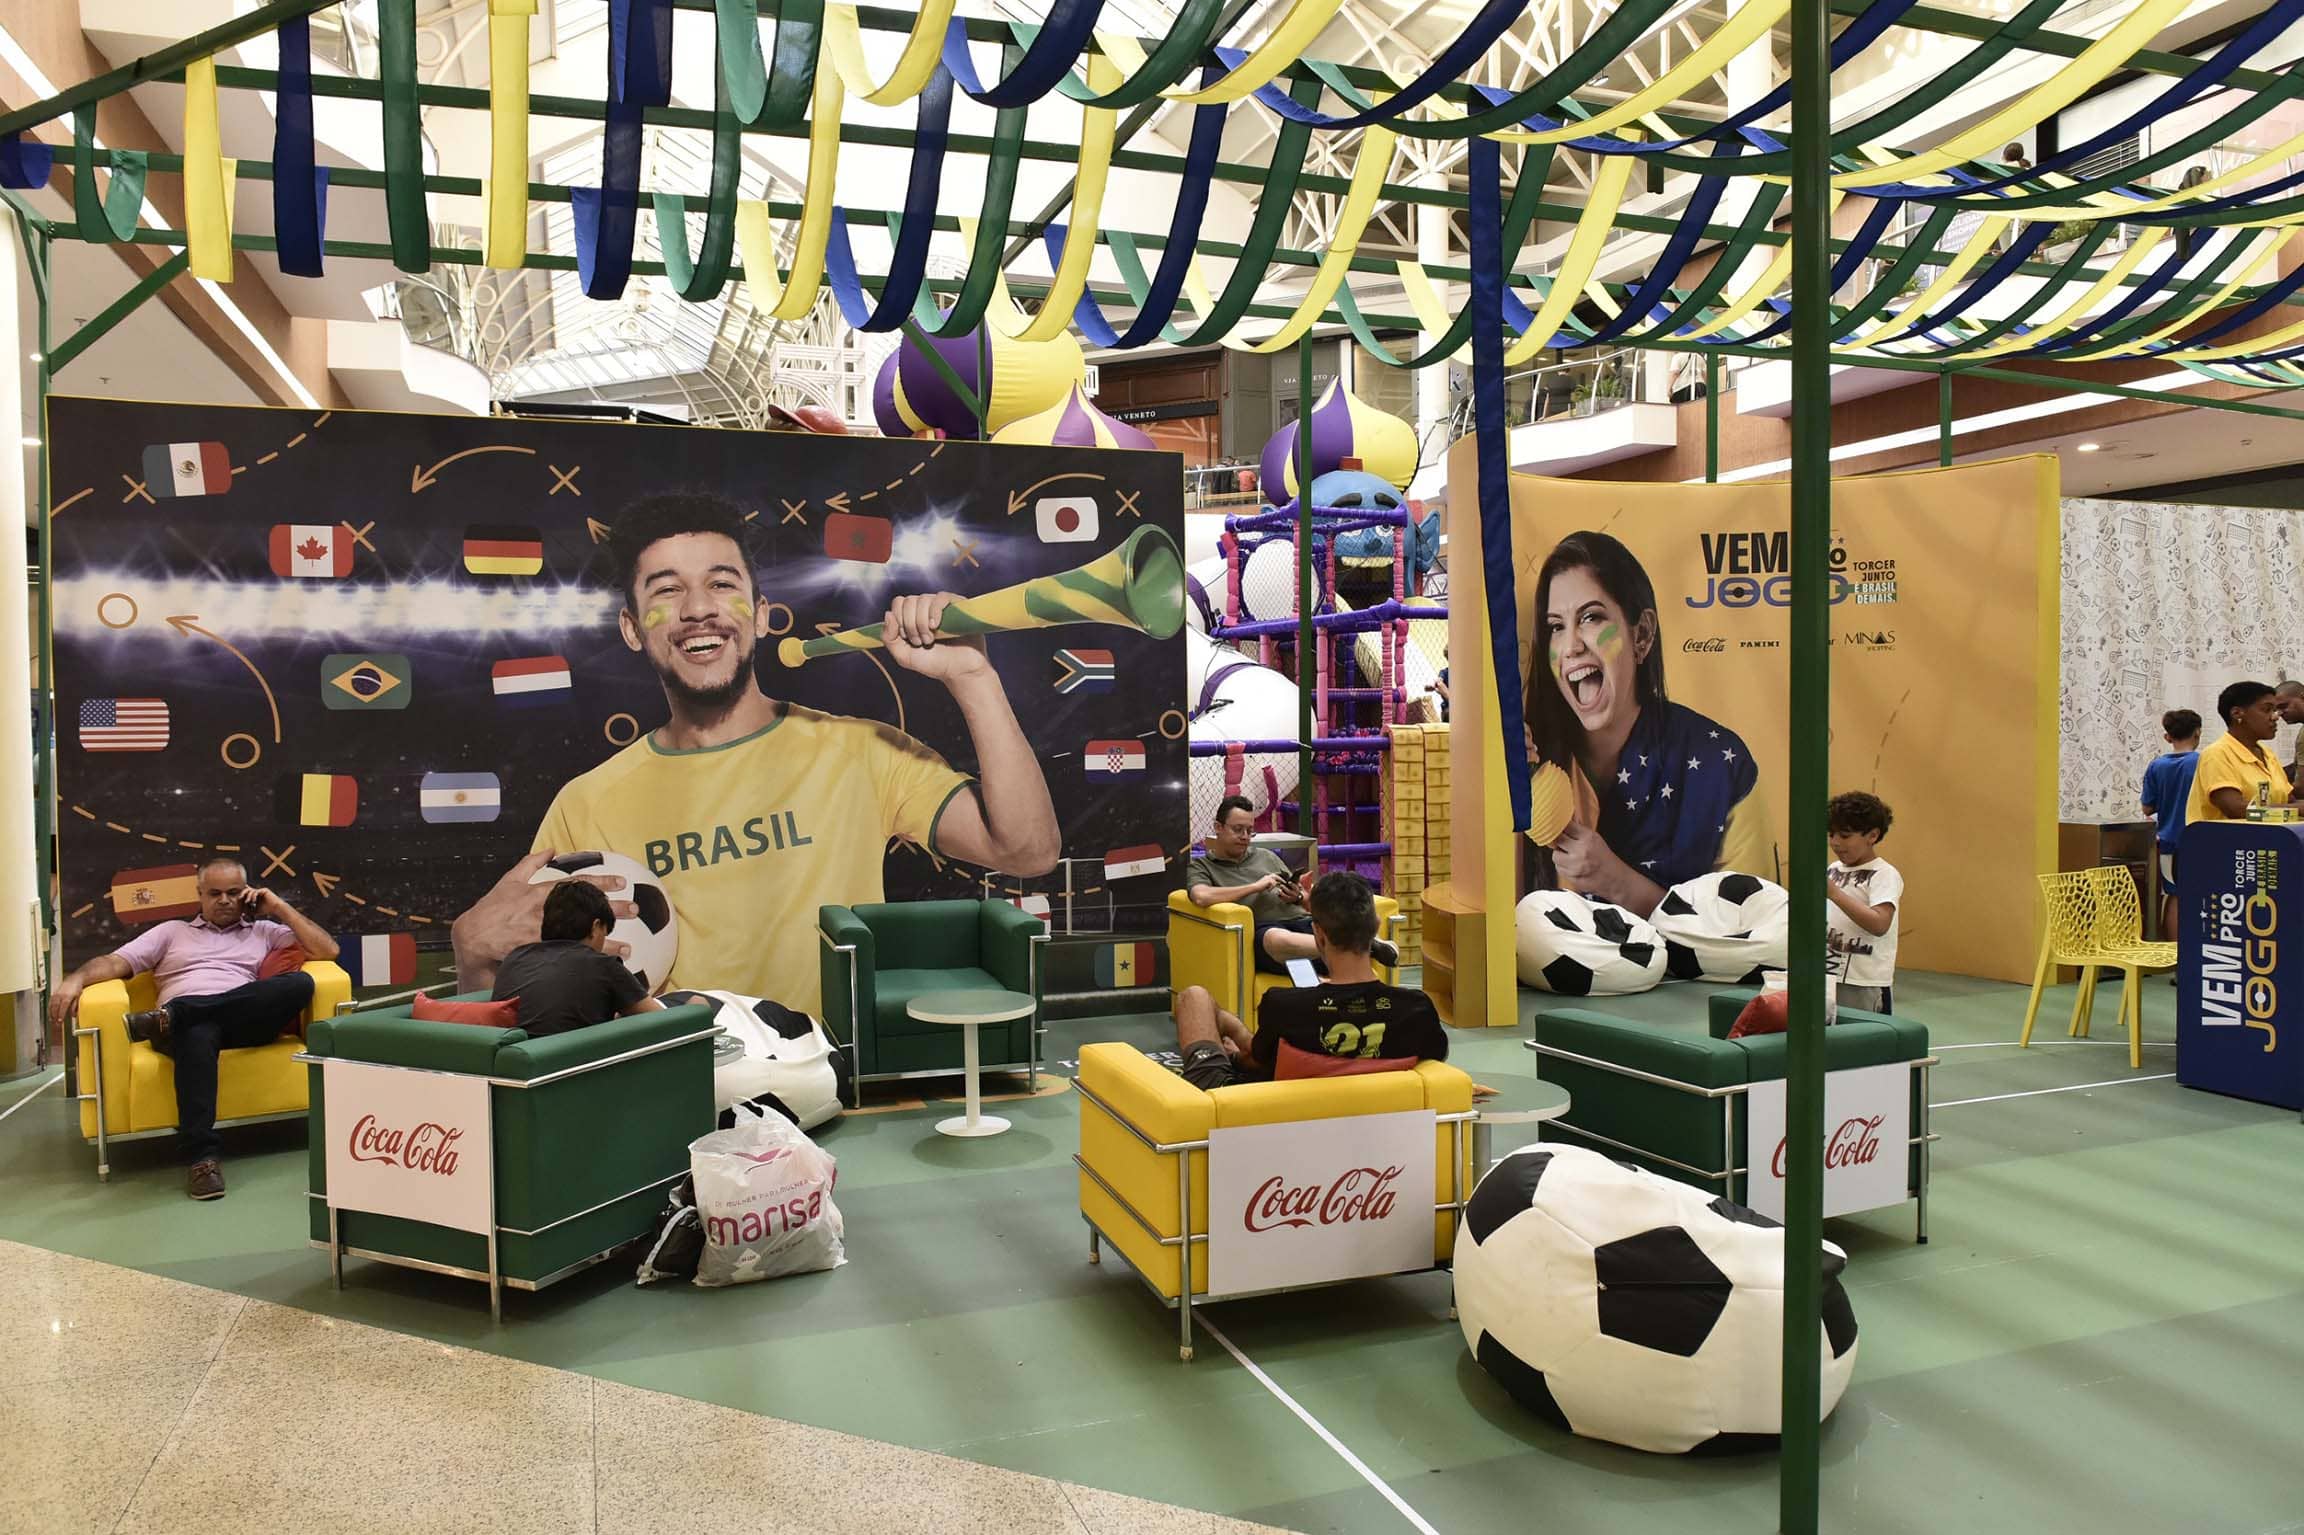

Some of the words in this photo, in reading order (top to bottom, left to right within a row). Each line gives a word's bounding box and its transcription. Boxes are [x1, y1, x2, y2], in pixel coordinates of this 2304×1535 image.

[1124, 411, 1156, 420] VENETO
[1700, 531, 1788, 575] VEM
[1853, 560, 1896, 571] TORCER
[1862, 571, 1896, 582] JUNTO
[1862, 582, 1896, 593] BRASIL
[645, 811, 813, 878] BRASIL
[2235, 850, 2245, 889] TORCER
[2246, 850, 2256, 882] JUNTO
[2220, 893, 2244, 942] PRO
[2202, 944, 2243, 1027] VEM
[2245, 893, 2278, 1052] JOGO
[708, 1191, 821, 1246] marisa
